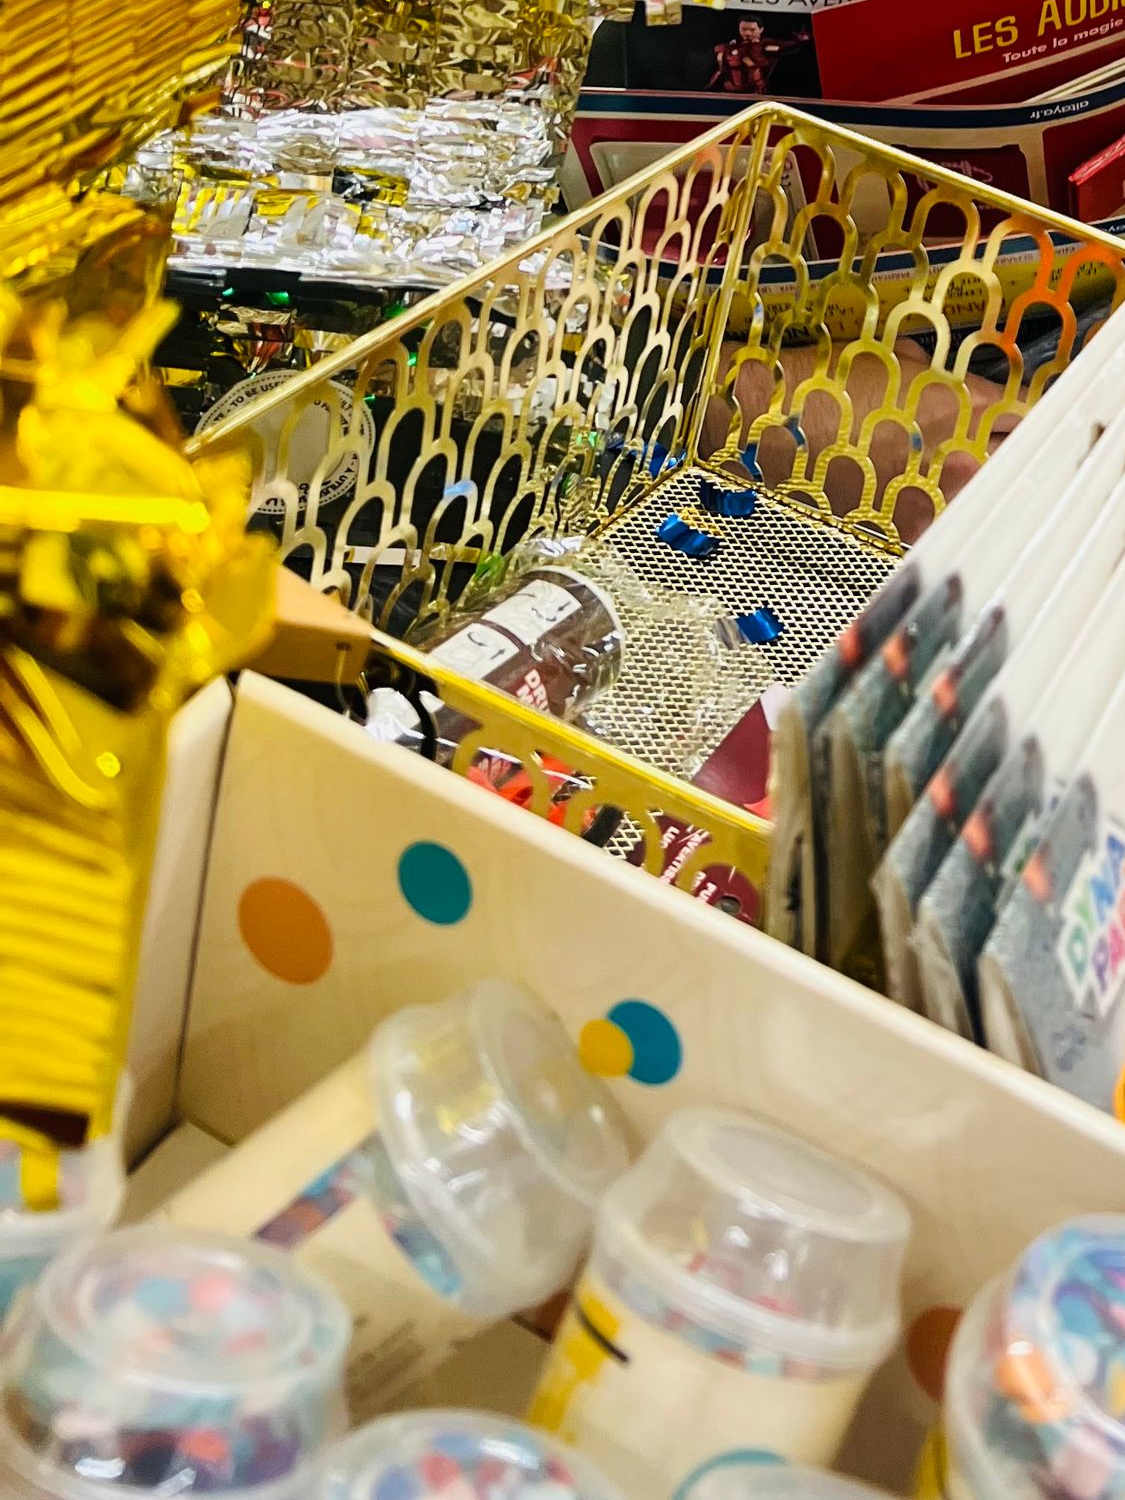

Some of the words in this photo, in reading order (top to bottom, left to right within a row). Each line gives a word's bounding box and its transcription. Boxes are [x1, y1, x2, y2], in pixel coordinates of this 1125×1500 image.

[952, 15, 1018, 60] LES
[1002, 46, 1047, 65] Toute
[1052, 35, 1069, 50] la
[1073, 17, 1125, 43] magie
[1029, 100, 1090, 121] altaya.fr
